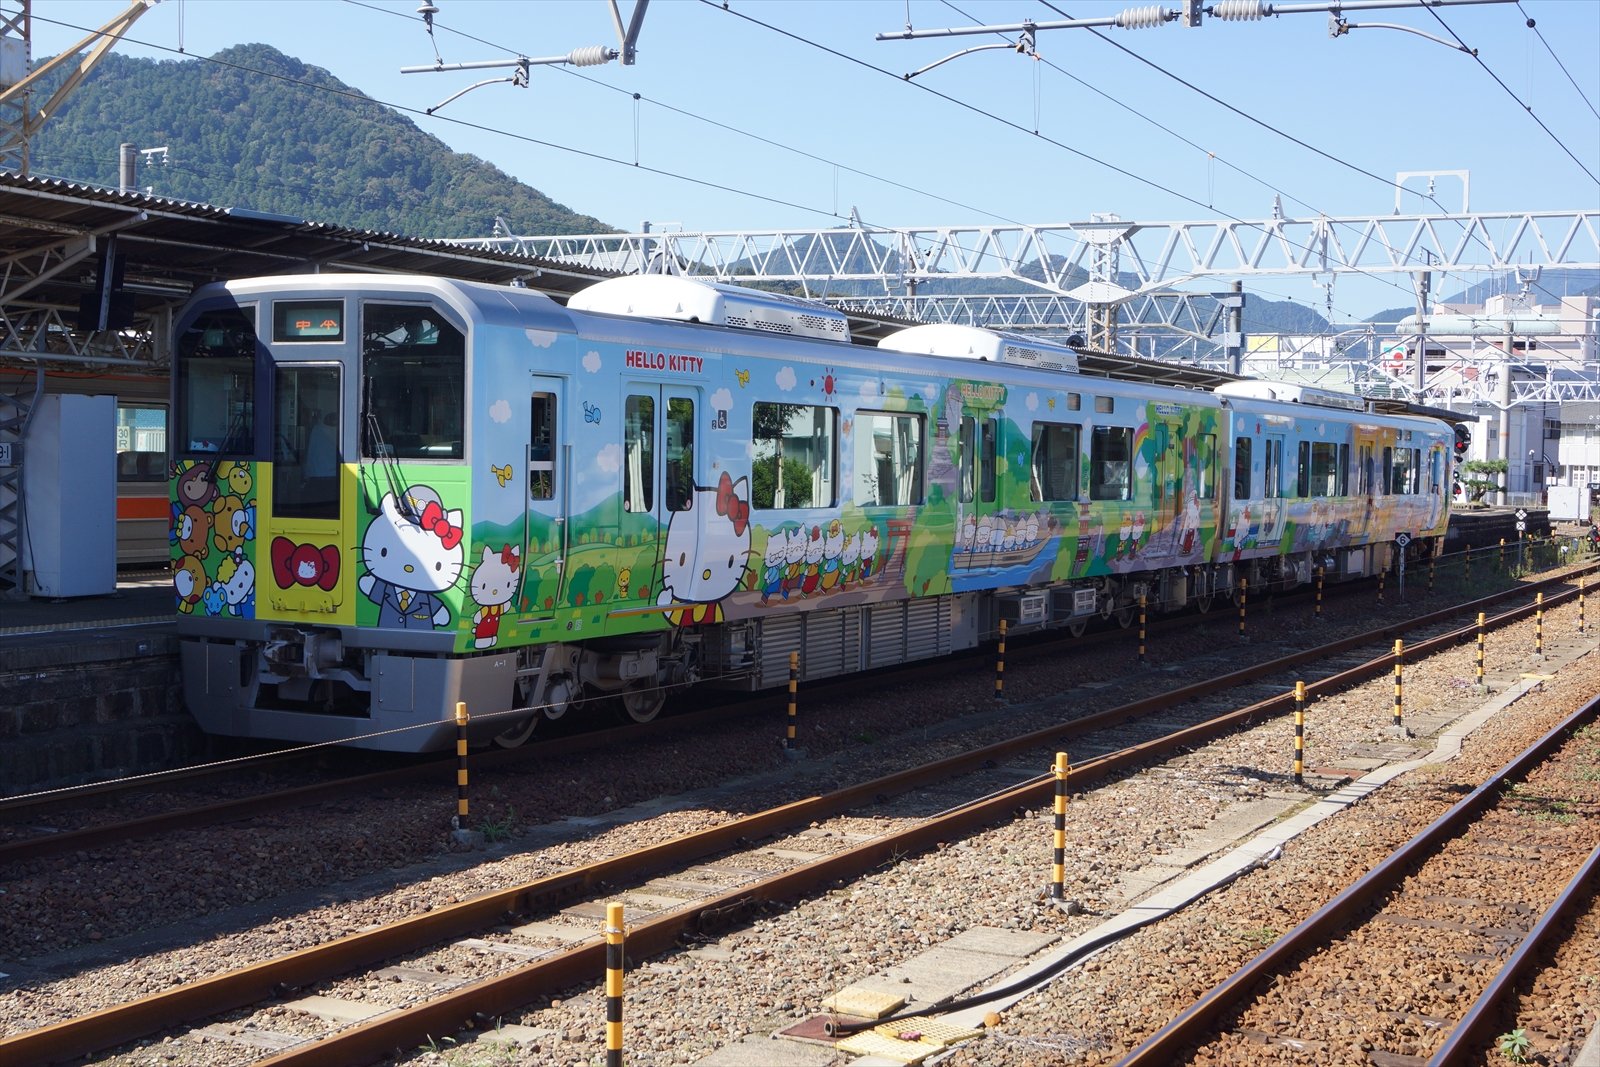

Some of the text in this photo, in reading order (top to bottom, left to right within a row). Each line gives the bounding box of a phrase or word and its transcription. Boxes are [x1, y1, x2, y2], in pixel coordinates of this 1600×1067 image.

[626, 350, 703, 373] HELLO KITTY
[961, 382, 1005, 401] HELLO KITTY
[118, 429, 128, 439] 30
[119, 440, 128, 448] R
[1400, 535, 1406, 545] 6
